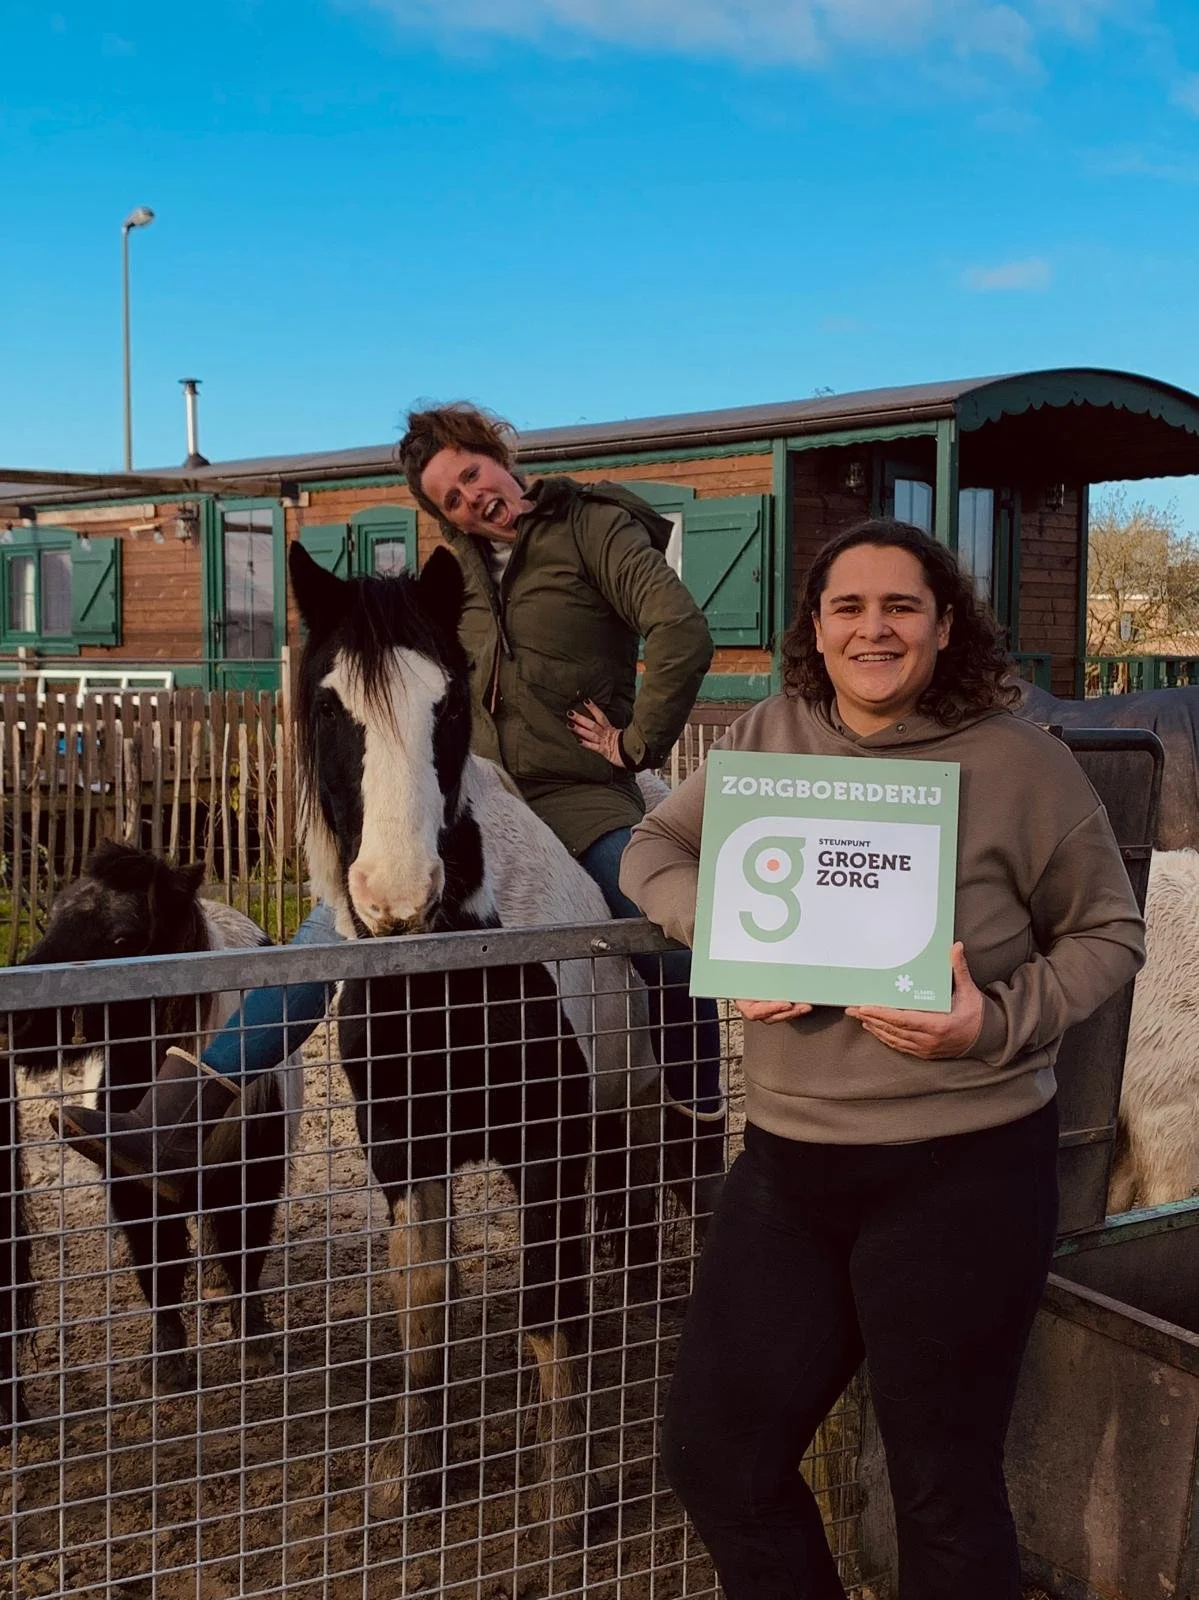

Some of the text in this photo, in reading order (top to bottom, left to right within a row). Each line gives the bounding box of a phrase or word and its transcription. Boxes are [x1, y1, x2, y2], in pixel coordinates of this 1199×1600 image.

[721, 775, 942, 806] ZORGBOERDERIJ
[818, 838, 871, 848] STEUNPUNT
[817, 850, 912, 872] GROENE
[816, 869, 880, 889] ZORG
